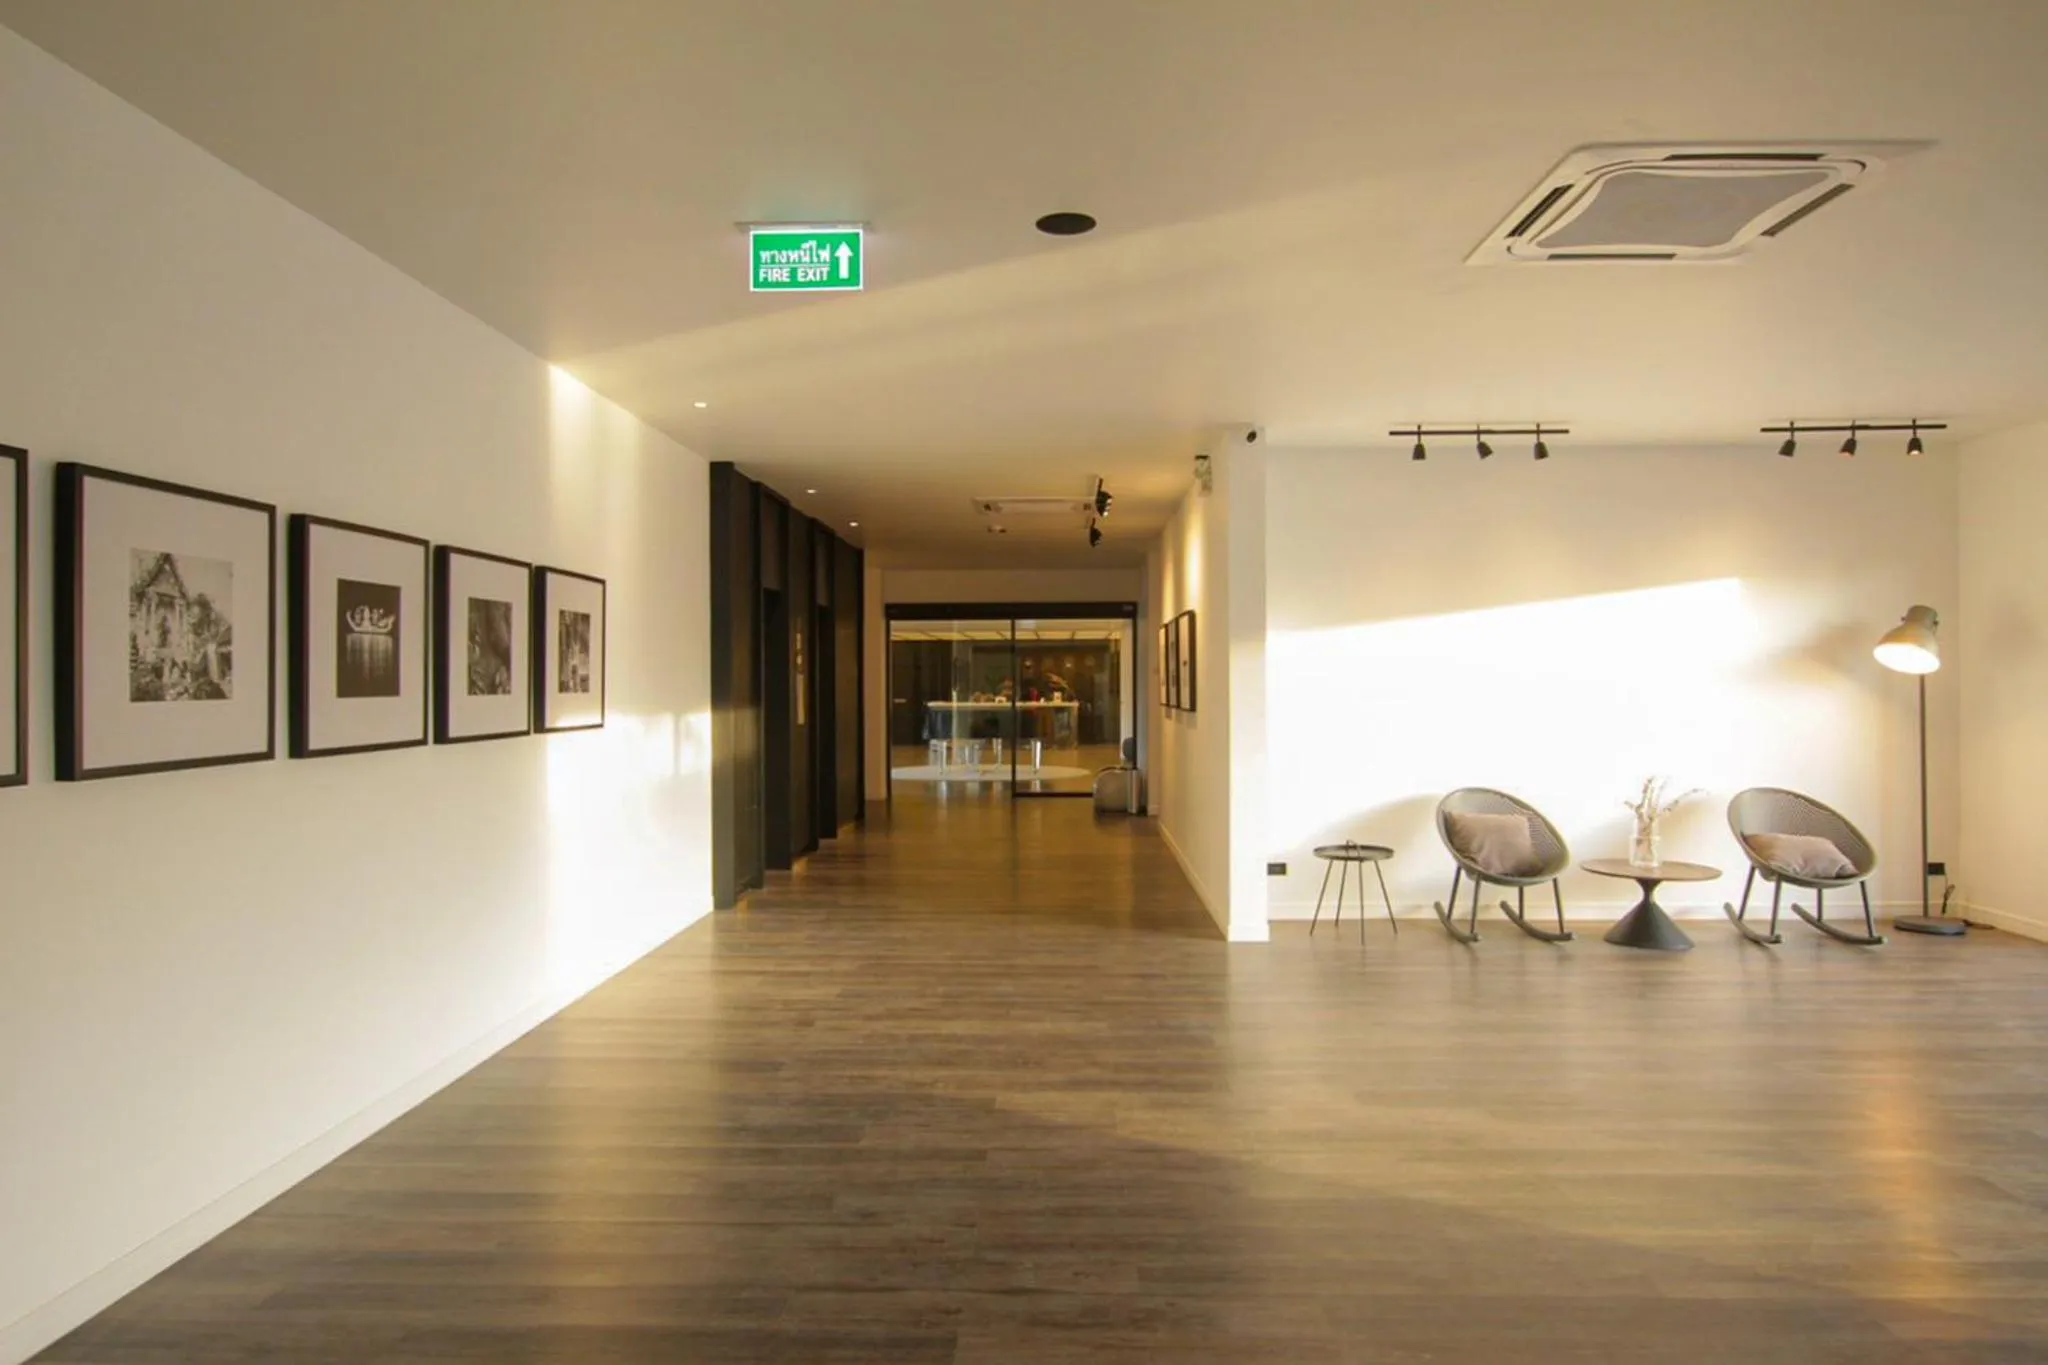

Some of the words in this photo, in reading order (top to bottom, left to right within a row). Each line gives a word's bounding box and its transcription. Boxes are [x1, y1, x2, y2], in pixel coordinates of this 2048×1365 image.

[759, 240, 830, 263] ทางหนีไฟ
[759, 268, 791, 282] FIRE
[797, 267, 830, 282] EXIT
